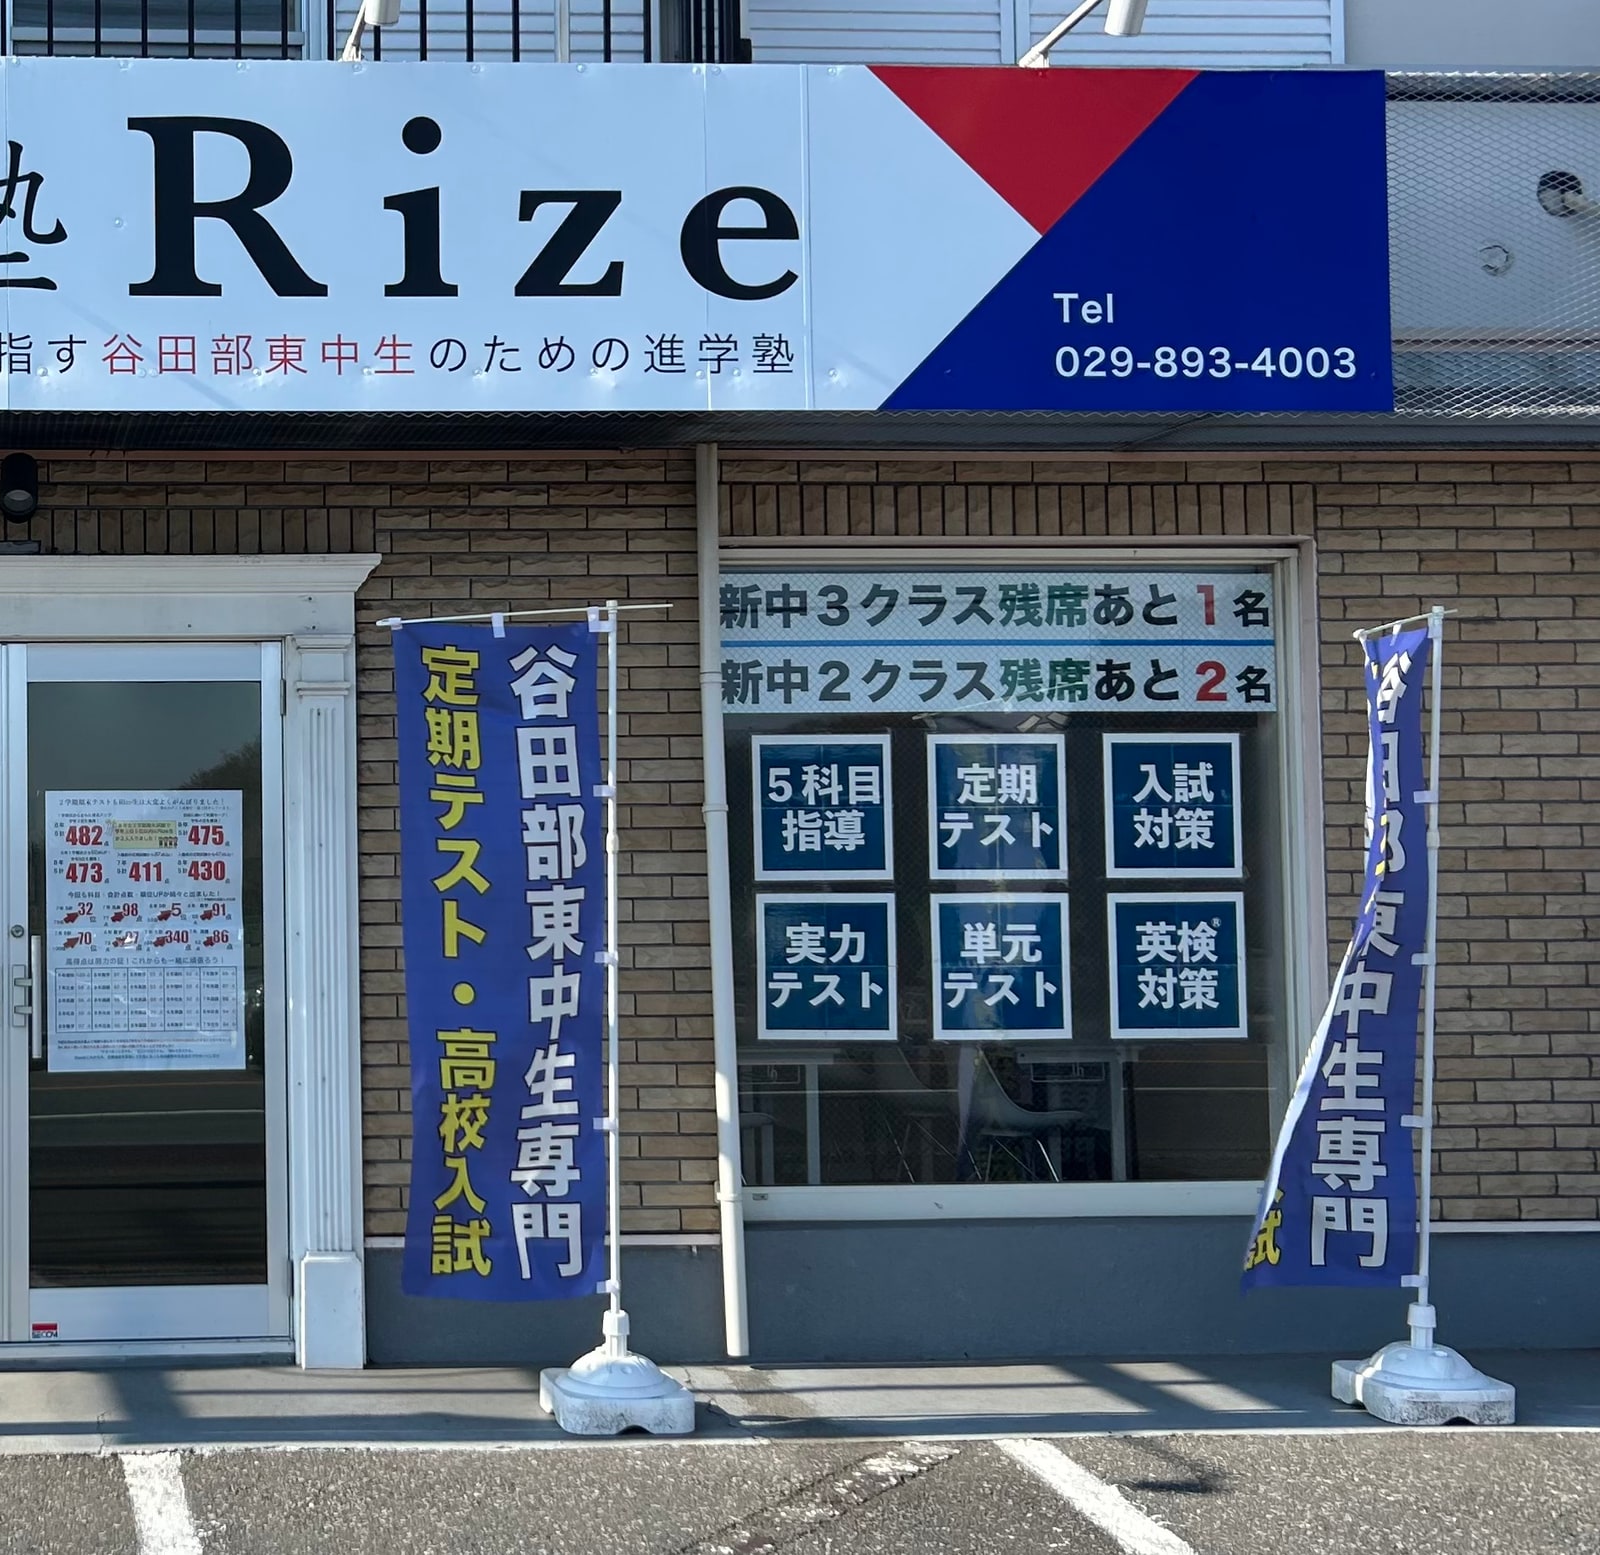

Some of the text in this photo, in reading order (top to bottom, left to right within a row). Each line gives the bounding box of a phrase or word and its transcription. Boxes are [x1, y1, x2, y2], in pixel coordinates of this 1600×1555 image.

[126, 115, 802, 301] Rize
[1054, 293, 1113, 324] Tel
[1055, 346, 1357, 379] 029-893-4003
[767, 763, 881, 805] 5科目
[956, 764, 1037, 805] 定期
[1132, 762, 1215, 802] 入試
[782, 810, 866, 852] 指導
[939, 811, 1054, 848] テスト
[1133, 807, 1215, 850] 対策
[420, 643, 497, 1277] 定期テスト・高校入試
[509, 643, 586, 1281] 谷田部東中生専門
[785, 923, 866, 965] 実力
[960, 922, 1042, 964] 単元
[768, 972, 884, 1008] テスト
[943, 971, 1057, 1008] テスト
[1137, 968, 1220, 1010] 対策
